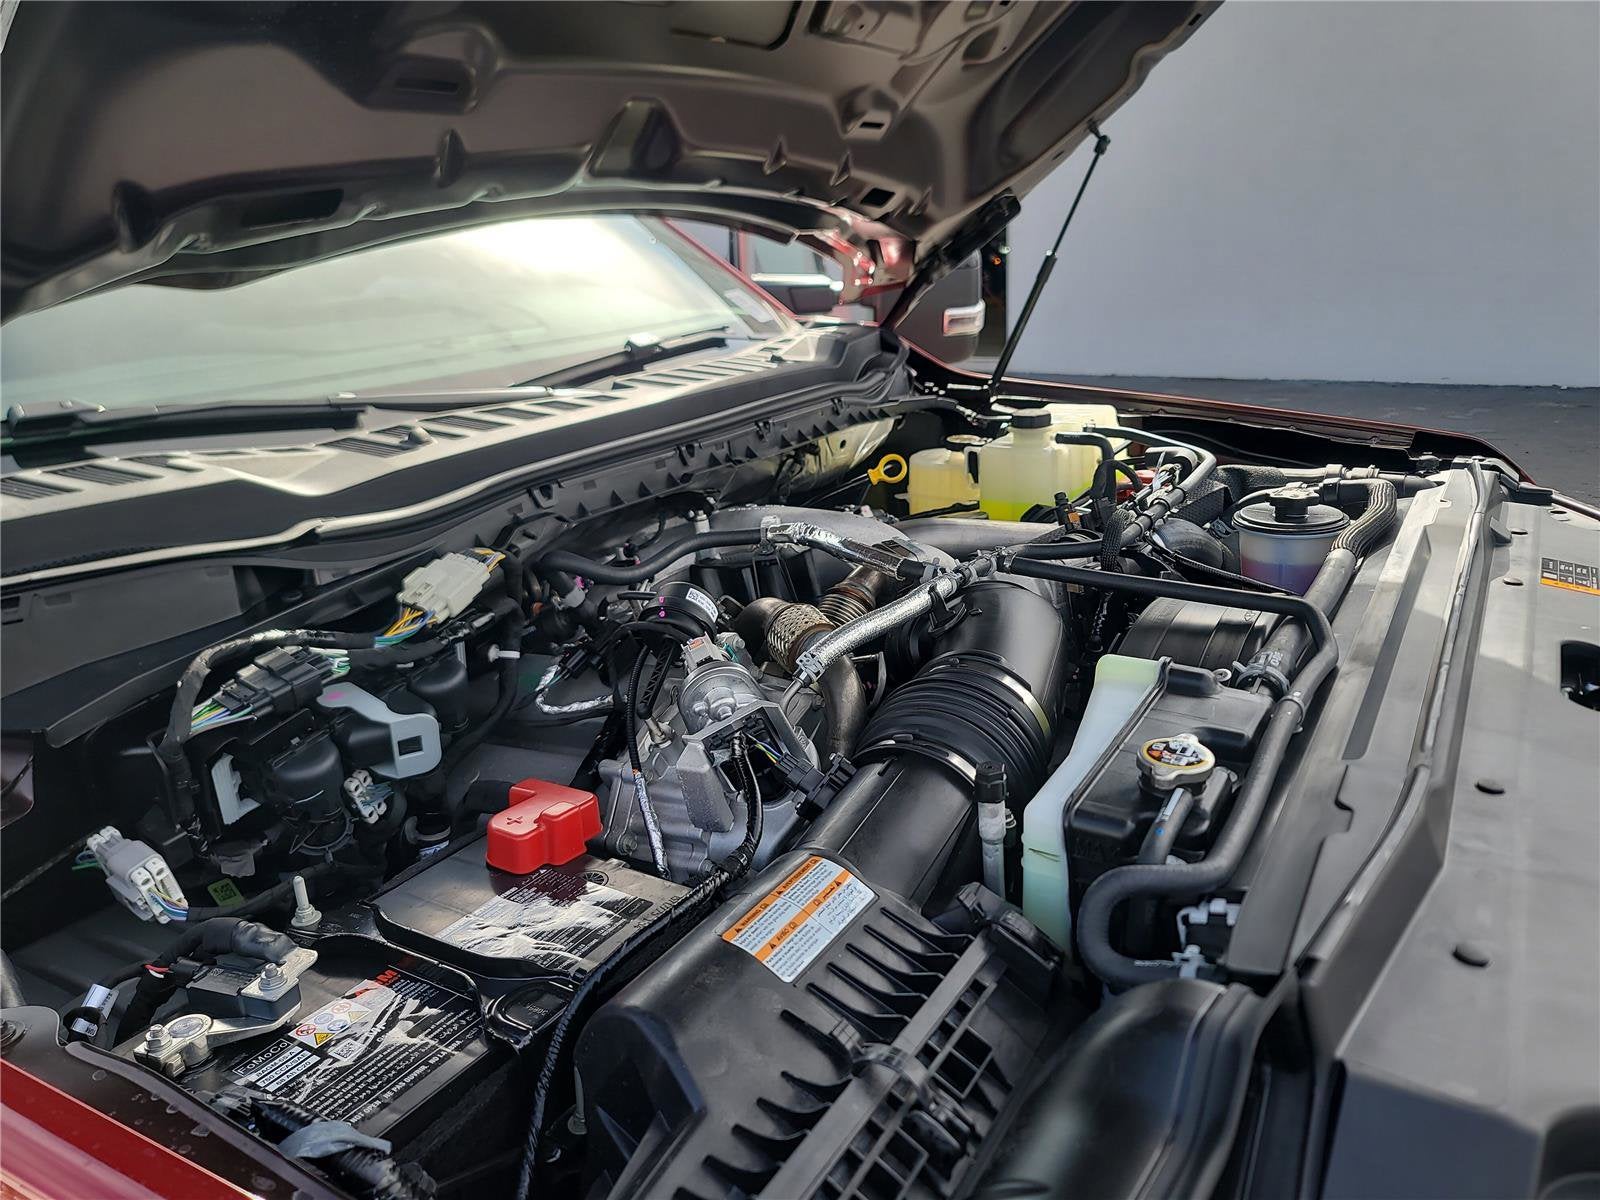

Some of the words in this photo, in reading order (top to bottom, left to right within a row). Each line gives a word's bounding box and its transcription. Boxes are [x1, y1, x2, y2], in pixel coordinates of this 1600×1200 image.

[741, 910, 761, 926] WARNING
[237, 1042, 288, 1075] FoMoCo
[350, 1112, 364, 1123] NOT
[383, 1090, 394, 1099] NE
[392, 1082, 406, 1092] PAS
[428, 1056, 439, 1064] NO
